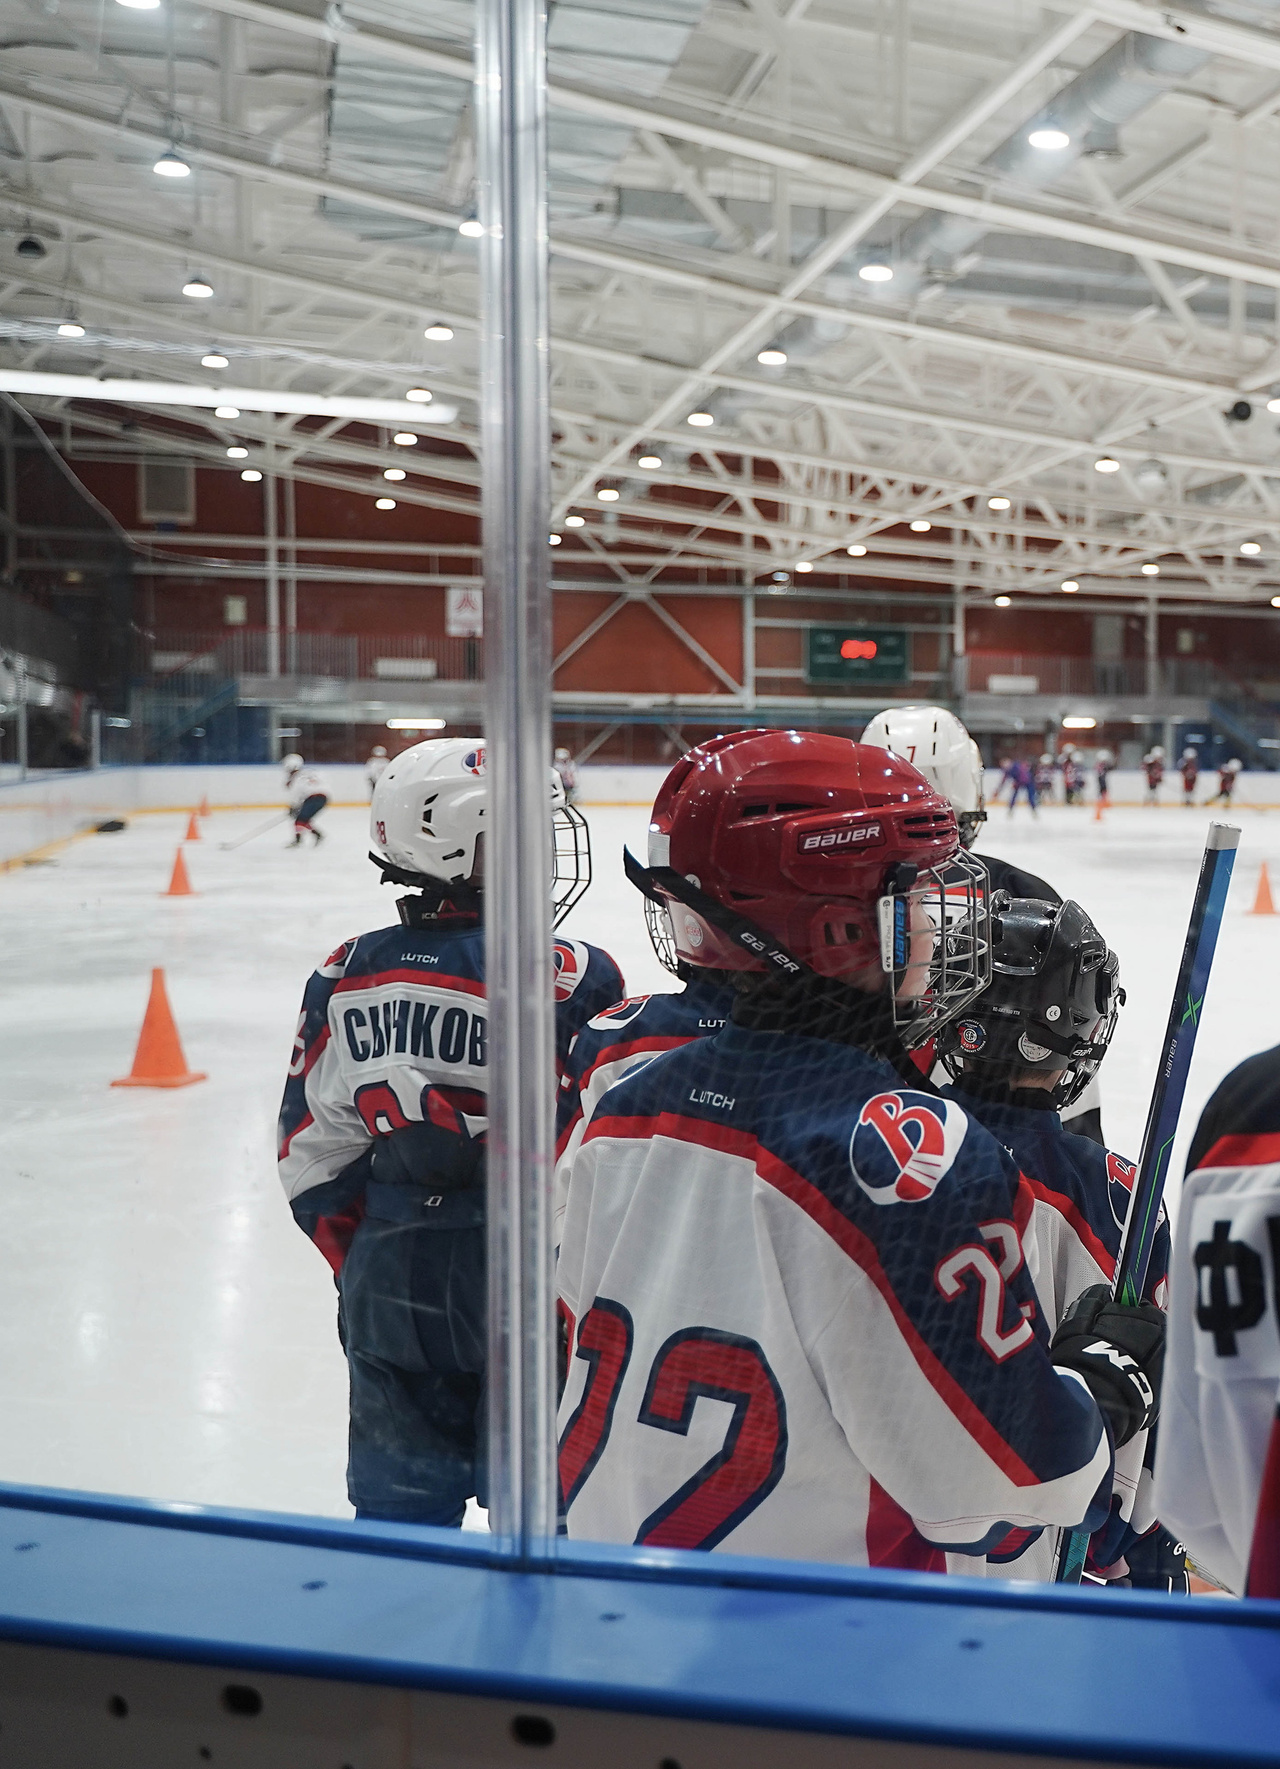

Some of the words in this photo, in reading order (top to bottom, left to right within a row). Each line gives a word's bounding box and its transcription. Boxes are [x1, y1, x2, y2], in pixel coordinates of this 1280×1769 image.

[803, 823, 881, 850] BAUER
[895, 900, 905, 964] BAUER
[401, 953, 439, 964] LUTCH
[698, 1019, 727, 1028] LUT
[1164, 1038, 1178, 1078] BAUER
[689, 1088, 736, 1112] LUTCH
